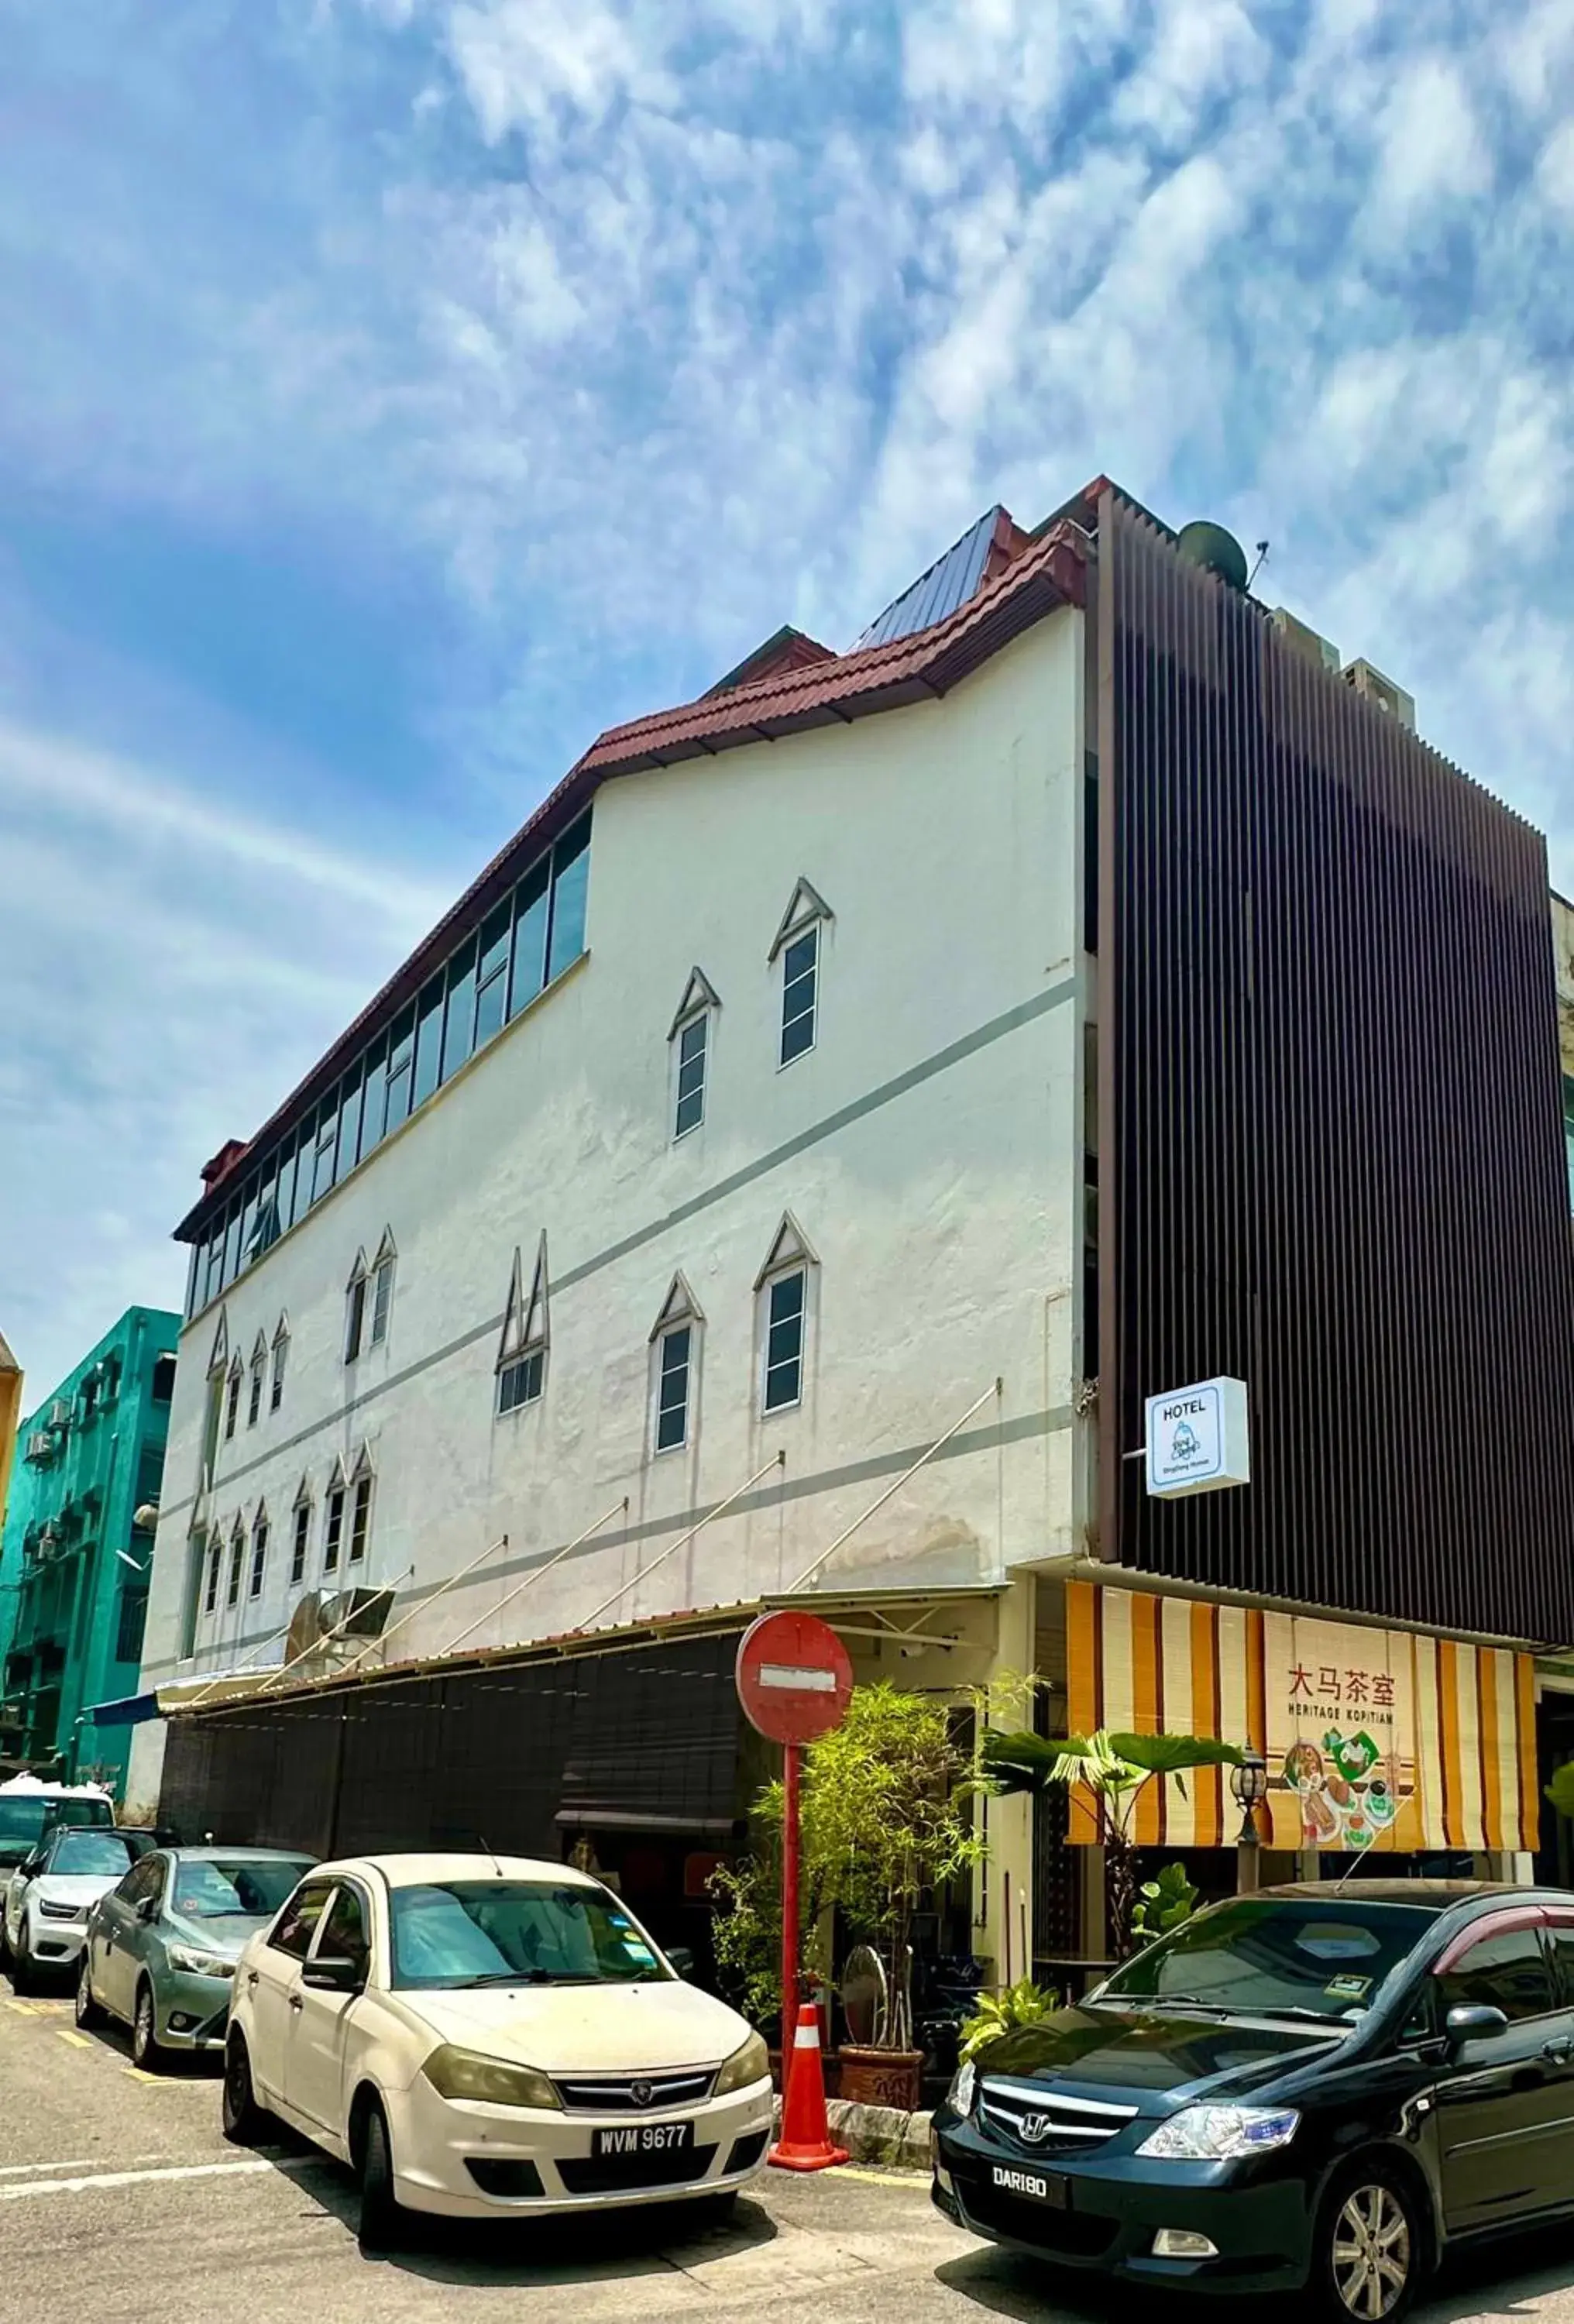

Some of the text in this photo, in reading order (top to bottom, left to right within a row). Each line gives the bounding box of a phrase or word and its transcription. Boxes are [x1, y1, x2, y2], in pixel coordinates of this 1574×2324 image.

[1163, 1398, 1206, 1421] HOTEL
[1288, 1662, 1396, 1707] 大马茶室
[600, 2124, 687, 2154] WVM 9677
